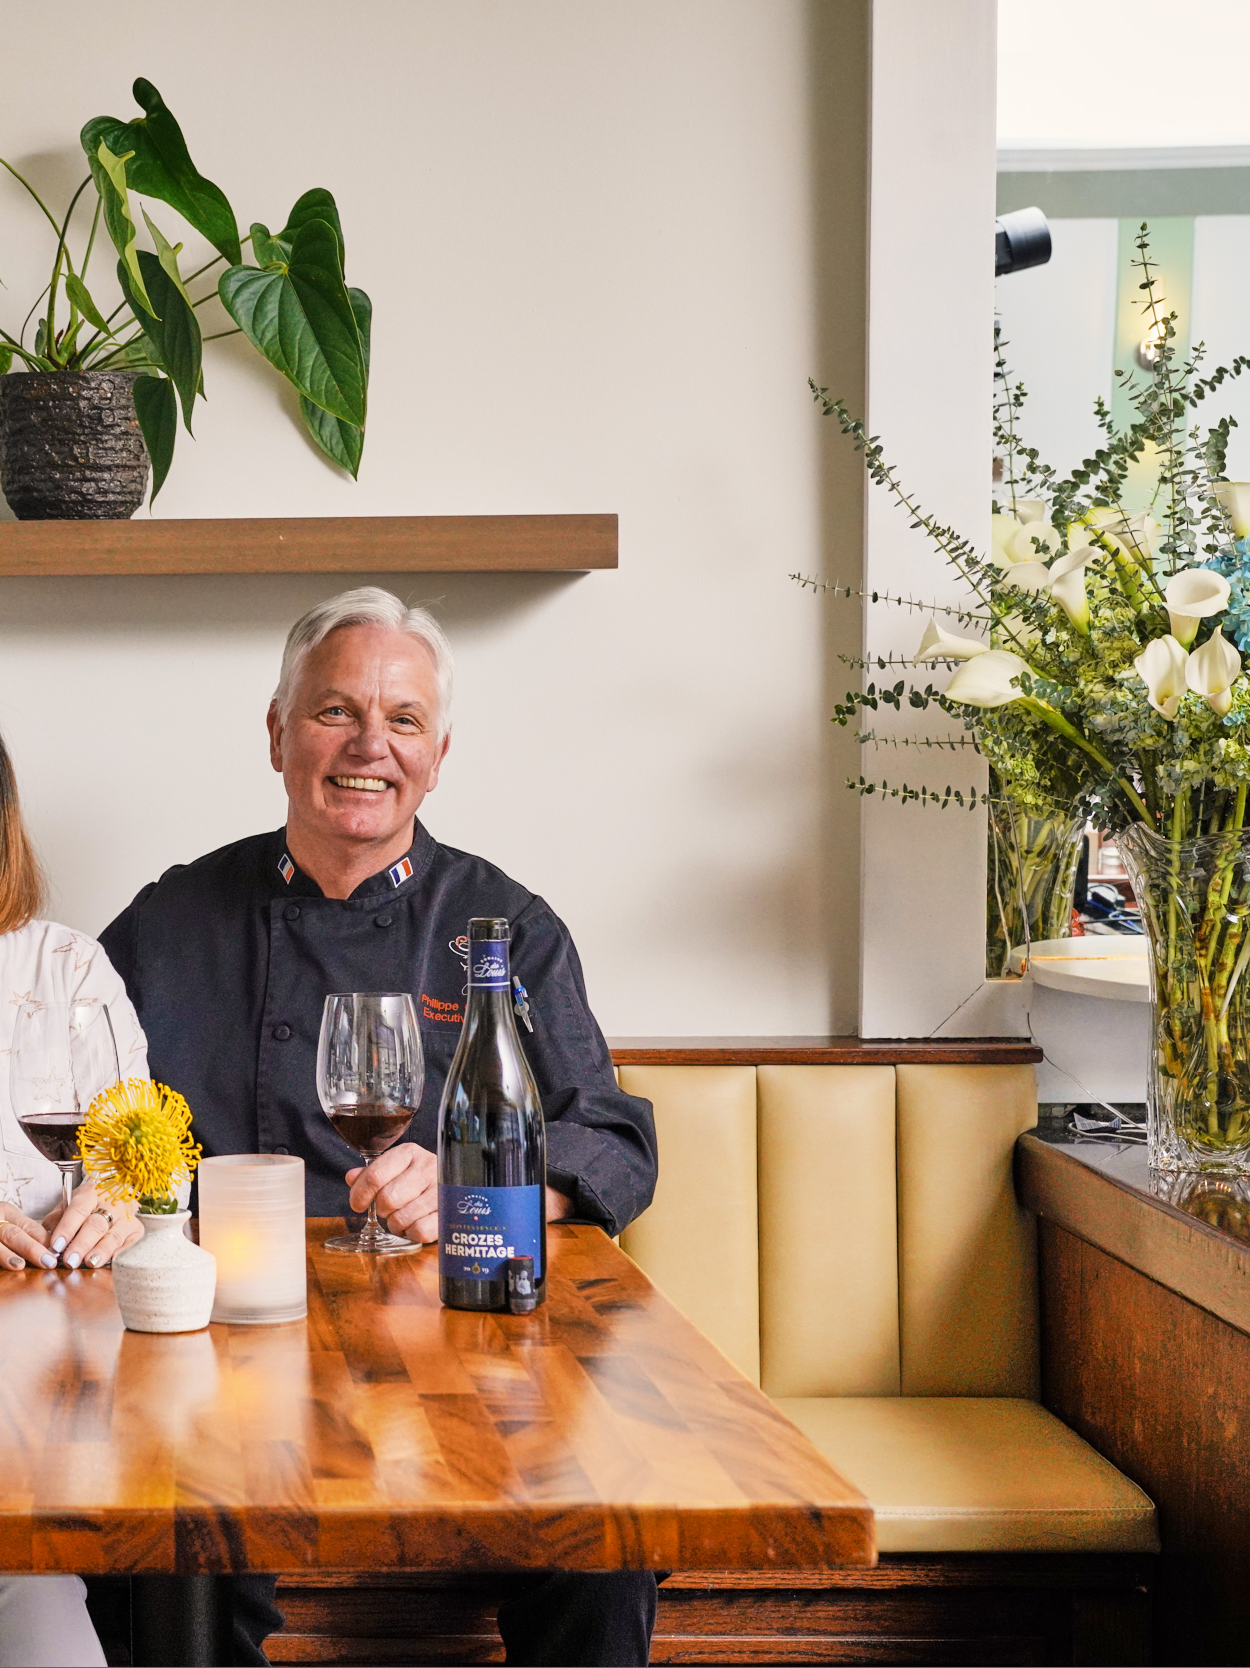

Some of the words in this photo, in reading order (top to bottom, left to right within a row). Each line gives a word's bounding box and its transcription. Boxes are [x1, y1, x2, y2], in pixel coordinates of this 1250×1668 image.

[422, 994, 459, 1011] Philippe
[423, 1007, 465, 1023] Executiv
[452, 1232, 503, 1245] CROZES
[445, 1243, 515, 1258] HERMITAGE
